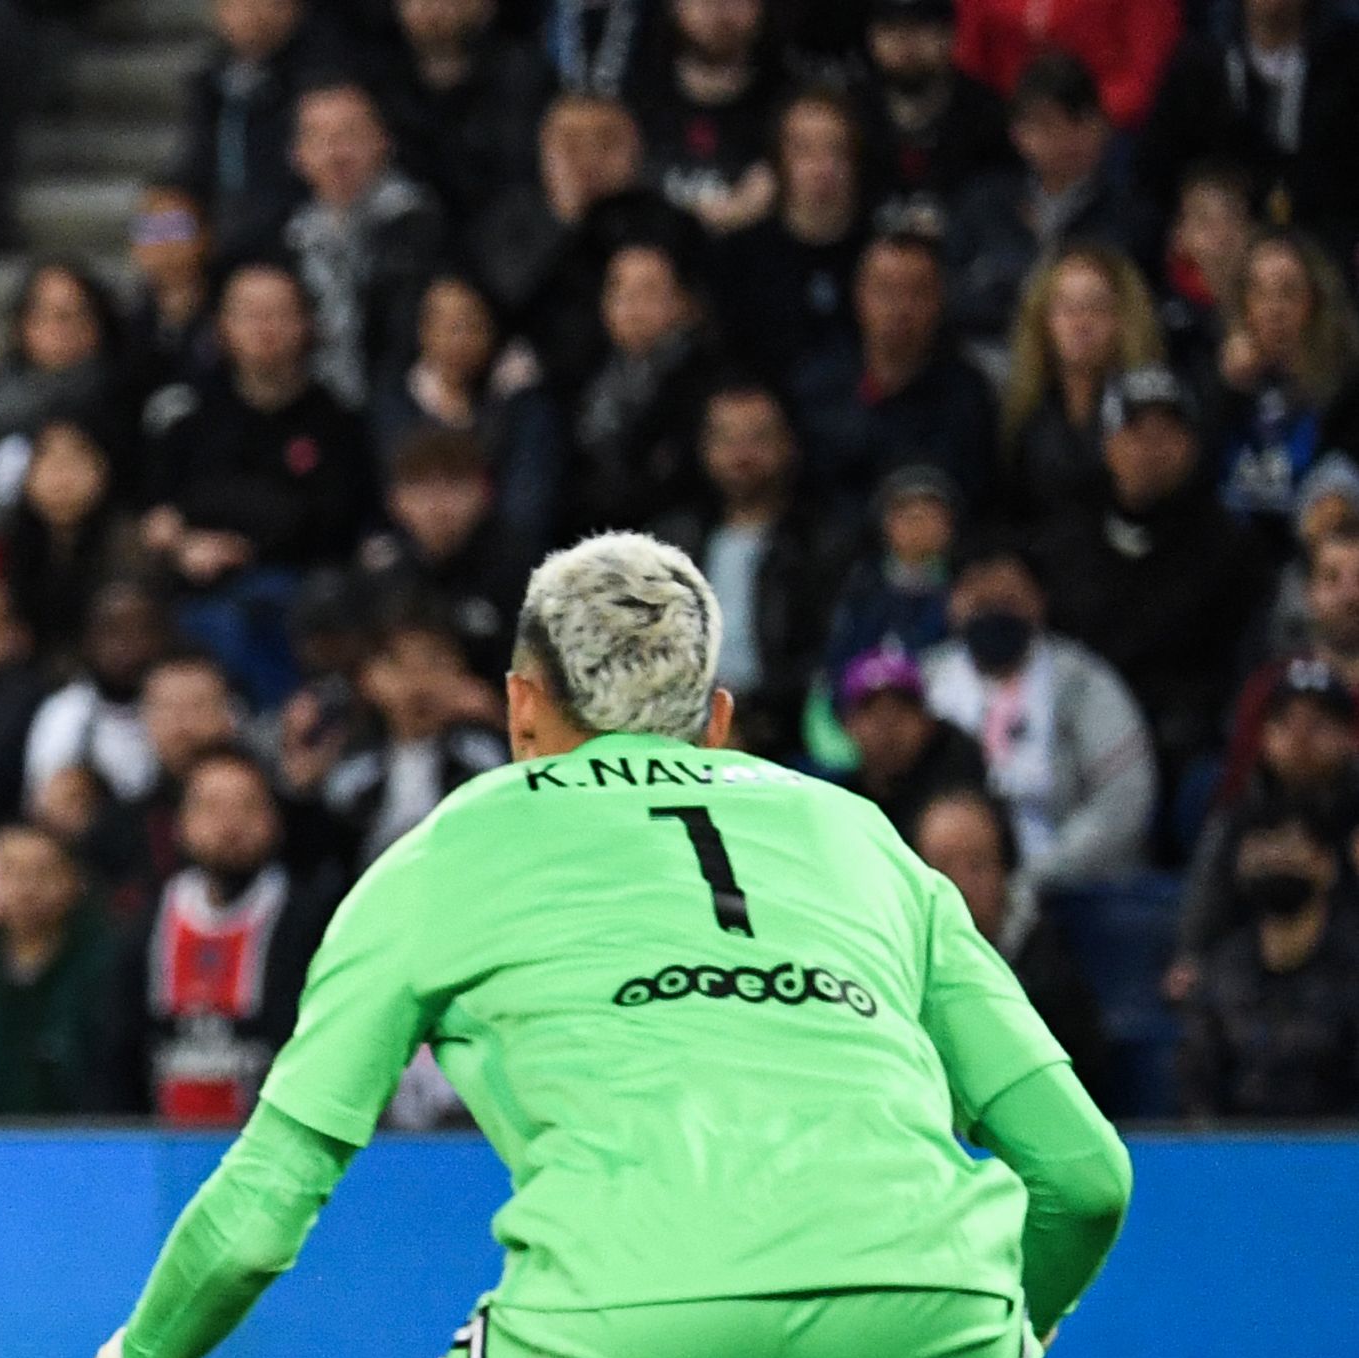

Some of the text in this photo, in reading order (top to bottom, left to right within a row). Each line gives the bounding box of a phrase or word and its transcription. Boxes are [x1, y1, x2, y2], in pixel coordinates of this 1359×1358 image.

[526, 757, 801, 791] K.NAV
[649, 805, 754, 938] 1
[612, 962, 877, 1017] ooredoo
